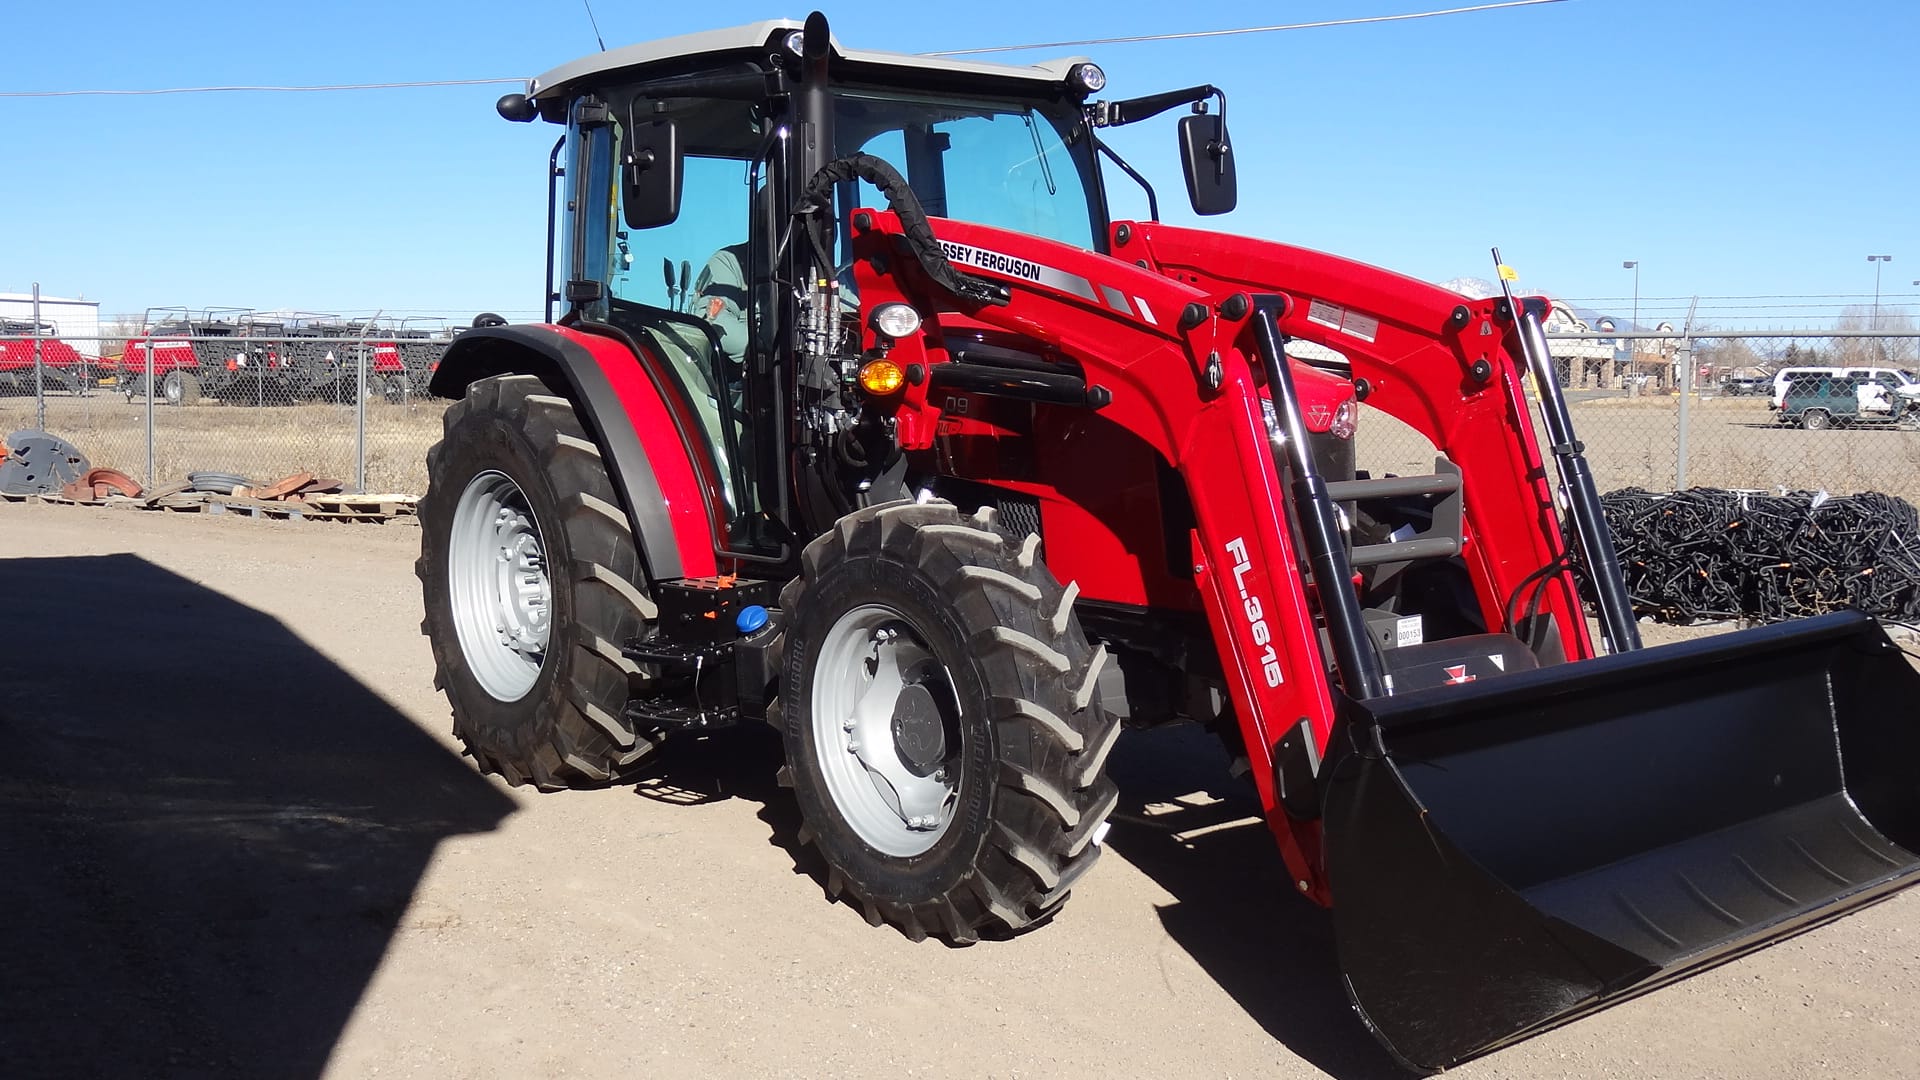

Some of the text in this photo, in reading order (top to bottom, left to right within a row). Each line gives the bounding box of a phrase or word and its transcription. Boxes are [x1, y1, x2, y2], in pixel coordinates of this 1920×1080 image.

[938, 241, 1041, 281] SSEY FERGUSON
[1225, 537, 1284, 688] FL.3615
